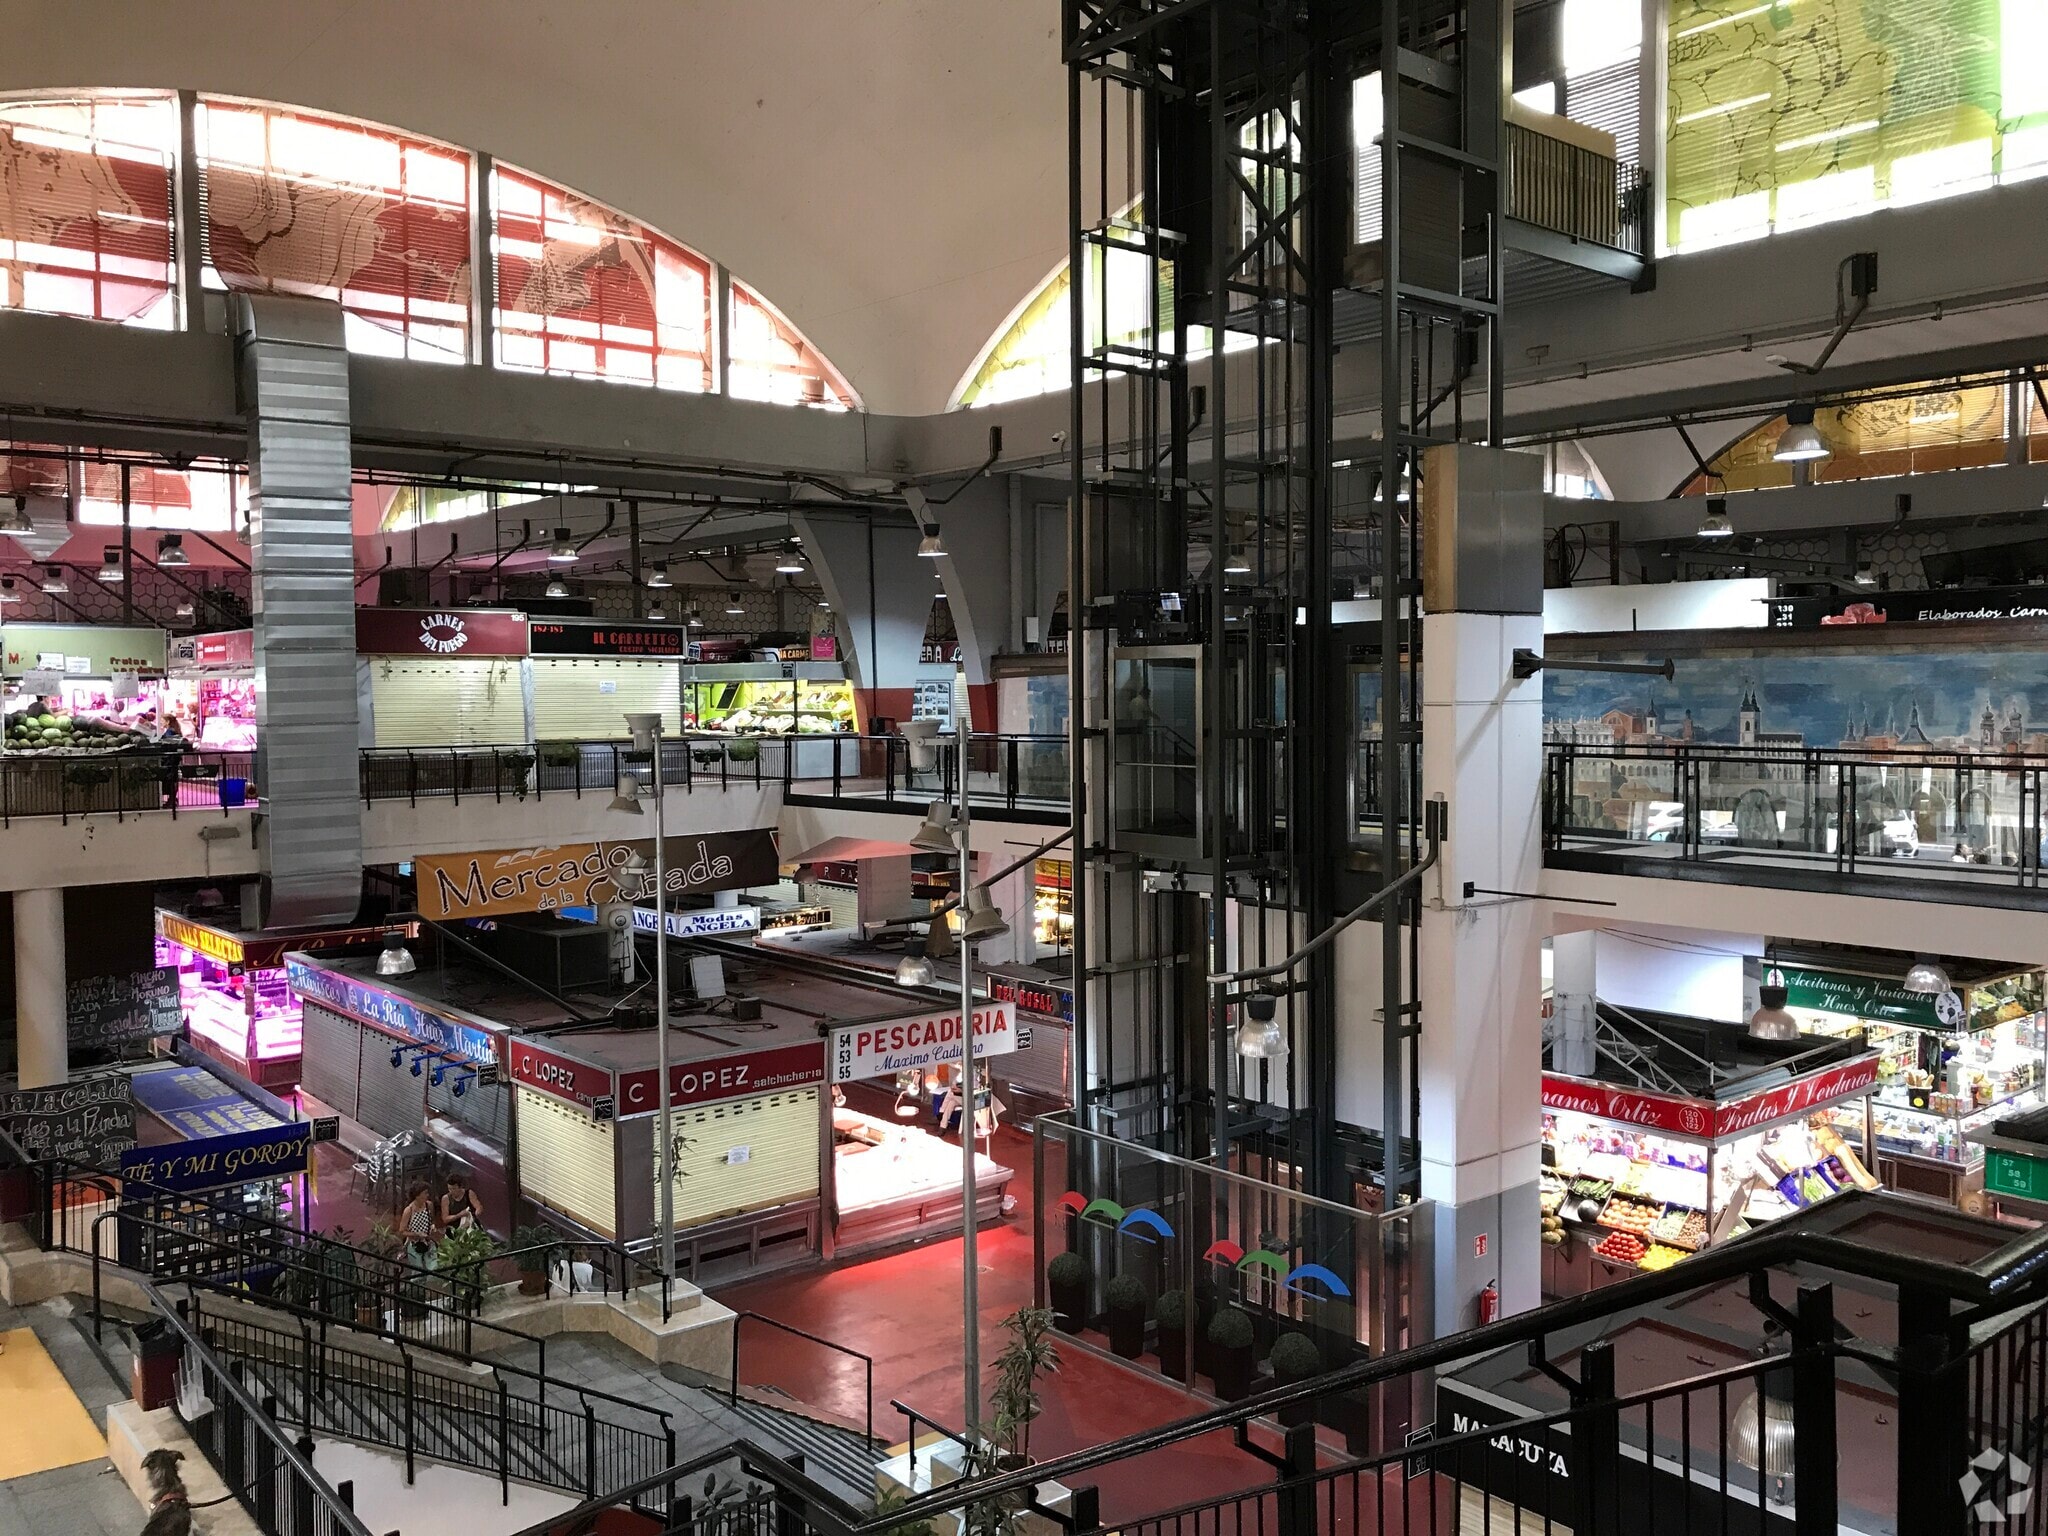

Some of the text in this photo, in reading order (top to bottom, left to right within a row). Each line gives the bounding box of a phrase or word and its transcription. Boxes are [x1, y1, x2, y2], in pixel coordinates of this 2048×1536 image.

[420, 613, 465, 632] CARNES
[511, 614, 525, 622] 195
[1918, 607, 2002, 620] Elaborados
[418, 631, 468, 653] DEL FUEGO
[436, 841, 634, 914] Mercado
[538, 893, 557, 911] de
[560, 888, 574, 905] la
[632, 910, 674, 936] ANGEA
[682, 919, 752, 934] ANGELA
[692, 913, 743, 925] Modas
[199, 929, 243, 962] SELECTAS
[1786, 972, 1851, 994] Aceitunas
[1856, 985, 1866, 1000] y
[297, 967, 340, 1003] Mariscos
[363, 991, 379, 1017] La
[414, 1010, 448, 1046] Hnos.
[996, 984, 1016, 1003] DEL
[1019, 989, 1054, 1012] ROSAL
[1864, 1000, 1896, 1018] Ortiz
[839, 1033, 851, 1048] 54
[839, 1050, 851, 1063] 53
[875, 1042, 984, 1072] Maximo Cadino
[522, 1055, 531, 1074] C
[535, 1060, 575, 1092] LOPEZ
[628, 1082, 644, 1103] C
[668, 1064, 750, 1097] OPEZ
[838, 1065, 851, 1080] 55
[1608, 1094, 1662, 1126] Ortiz
[1718, 1100, 1778, 1134] Frutas
[1805, 1070, 1872, 1106] Verduras
[1684, 1109, 1699, 1118] 120
[1685, 1122, 1699, 1130] 122
[159, 1157, 182, 1180] Y
[183, 1150, 221, 1177] MI
[224, 1135, 311, 1176] GORDY
[2007, 1169, 2021, 1178] 58
[2013, 1179, 2027, 1189] 59
[1453, 1412, 1570, 1478] MAACUYA
